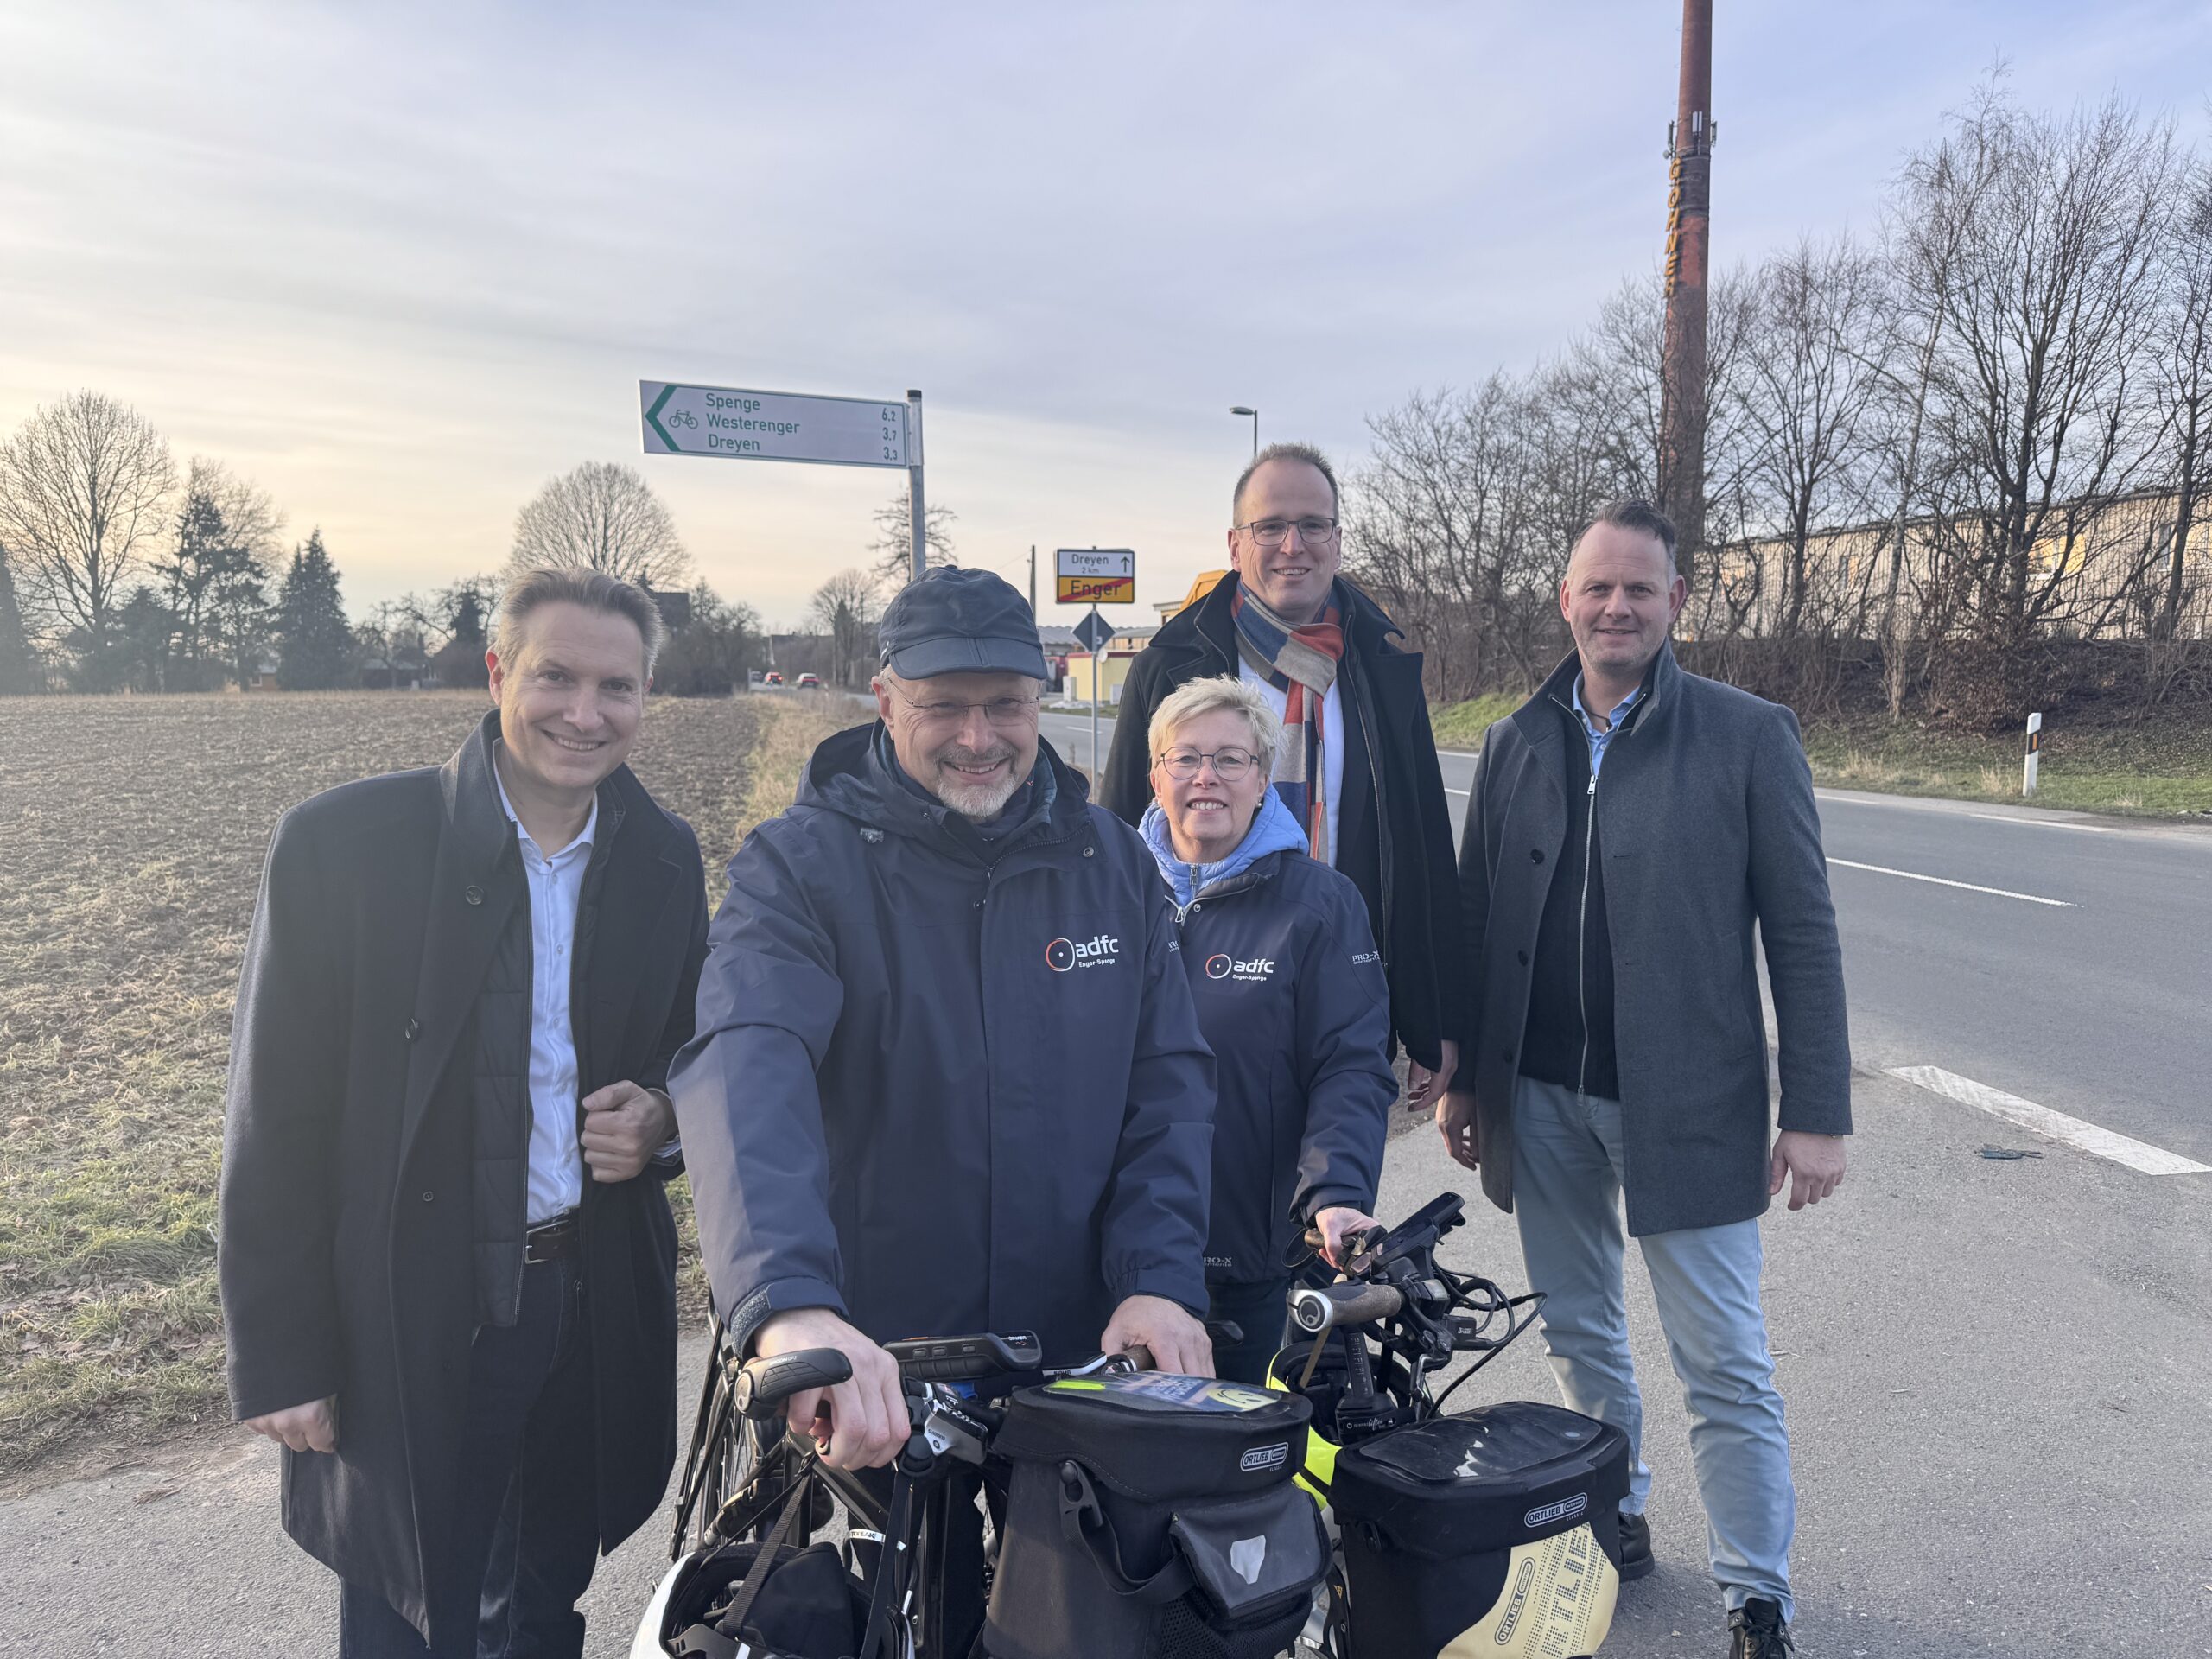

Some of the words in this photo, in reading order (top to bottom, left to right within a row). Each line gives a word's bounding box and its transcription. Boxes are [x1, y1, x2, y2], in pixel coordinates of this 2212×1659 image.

[706, 393, 760, 411] Spenge
[881, 408, 896, 422] 6.2
[706, 413, 800, 435] Westerenger
[883, 427, 897, 441] 3.7
[709, 434, 760, 453] Dreyen
[884, 447, 898, 461] 3.3
[1071, 554, 1109, 566] Dreyen
[1071, 580, 1122, 600] Enger
[1075, 935, 1119, 957] adfc
[1233, 958, 1274, 973] adfc
[1243, 1452, 1269, 1465] ORTLIEB
[1529, 1506, 1560, 1522] ORTLIEB
[1541, 1523, 1590, 1659] RTLIE
[1498, 1597, 1522, 1641] ORTLIEB
